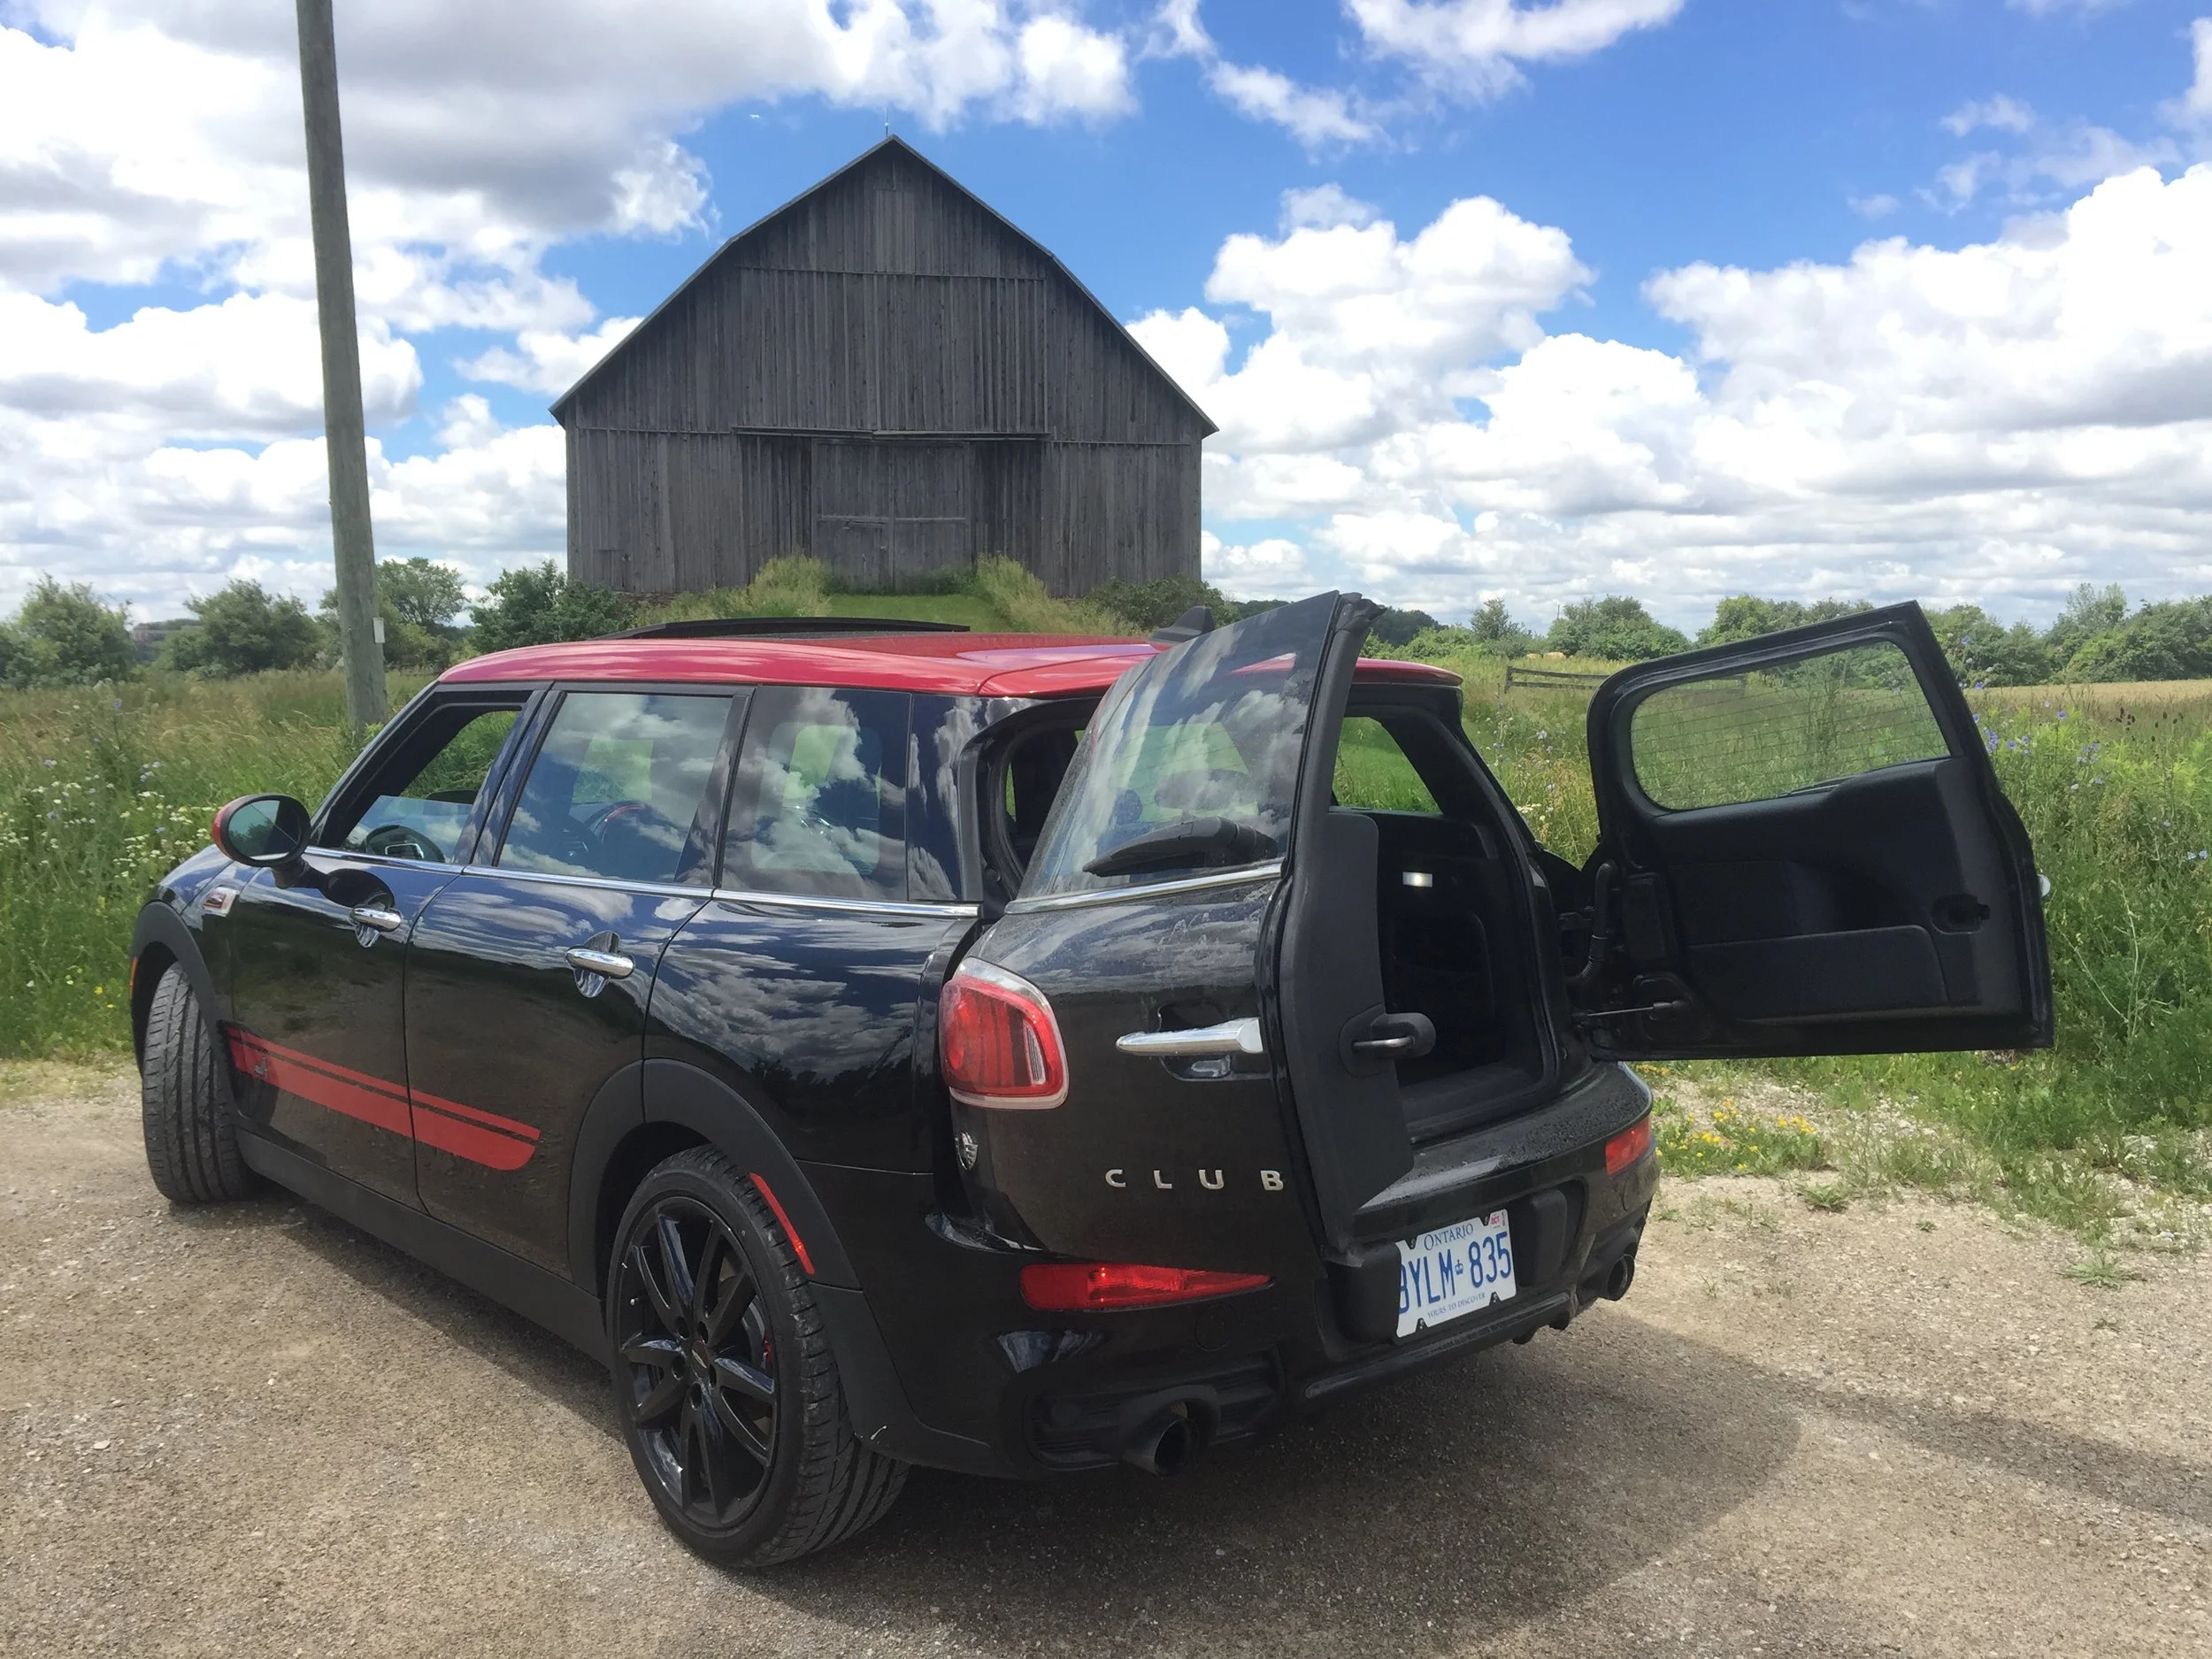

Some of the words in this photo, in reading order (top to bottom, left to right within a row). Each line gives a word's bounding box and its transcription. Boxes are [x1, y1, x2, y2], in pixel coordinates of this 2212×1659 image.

[1105, 1169, 1284, 1191] CLUB
[1424, 1223, 1474, 1251] ONTARIO
[1399, 1248, 1455, 1315] BYLM
[1468, 1231, 1512, 1288] 835
[1427, 1305, 1448, 1318] YOURS
[1458, 1292, 1486, 1308] DISCOVER
